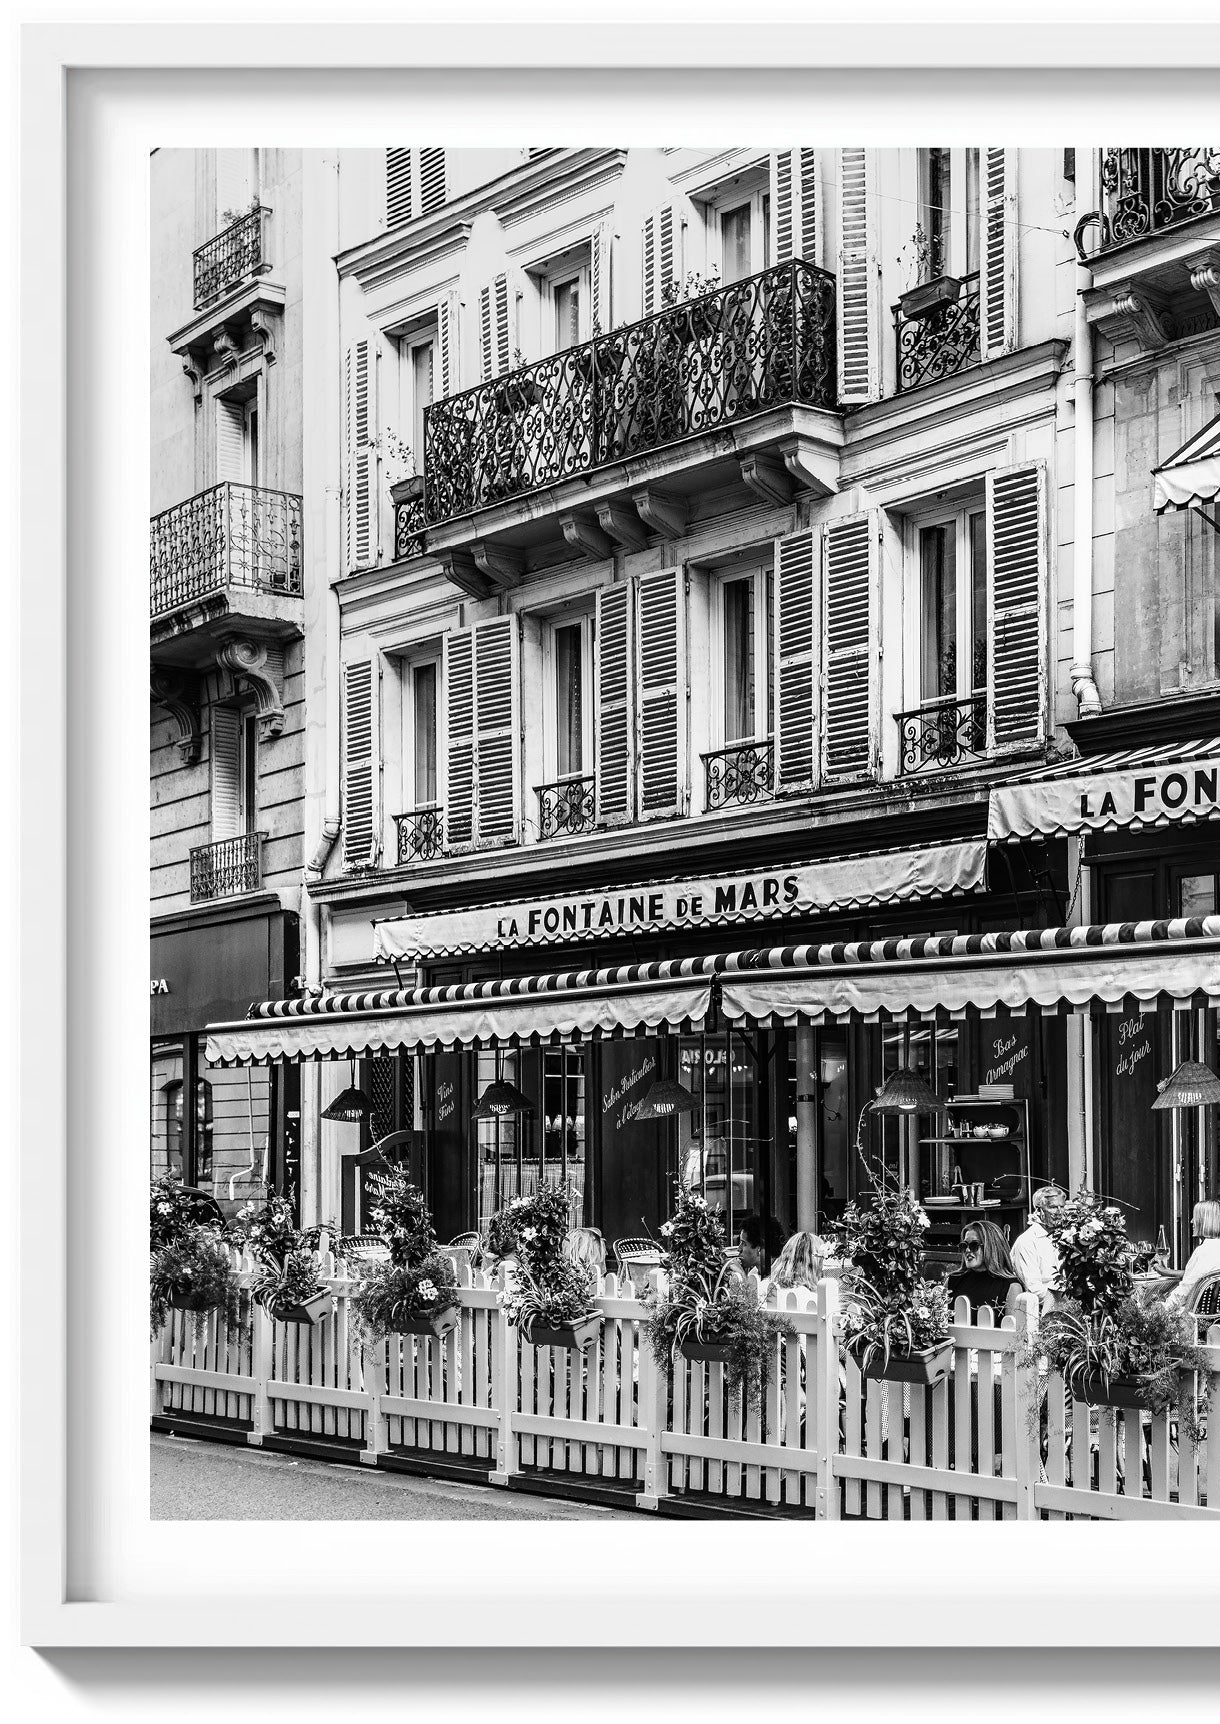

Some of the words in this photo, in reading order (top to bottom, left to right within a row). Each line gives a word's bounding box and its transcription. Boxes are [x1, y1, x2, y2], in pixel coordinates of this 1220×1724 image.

[1080, 791, 1118, 818] LA
[497, 918, 519, 938] LA
[528, 893, 664, 935] FONTAINE
[676, 896, 702, 918] DE
[714, 876, 799, 914] MARS
[150, 978, 170, 995] PA
[1118, 1012, 1146, 1046] Plat
[993, 1034, 1017, 1059] Bas
[1116, 1053, 1129, 1076] du
[1128, 1040, 1152, 1076] jour
